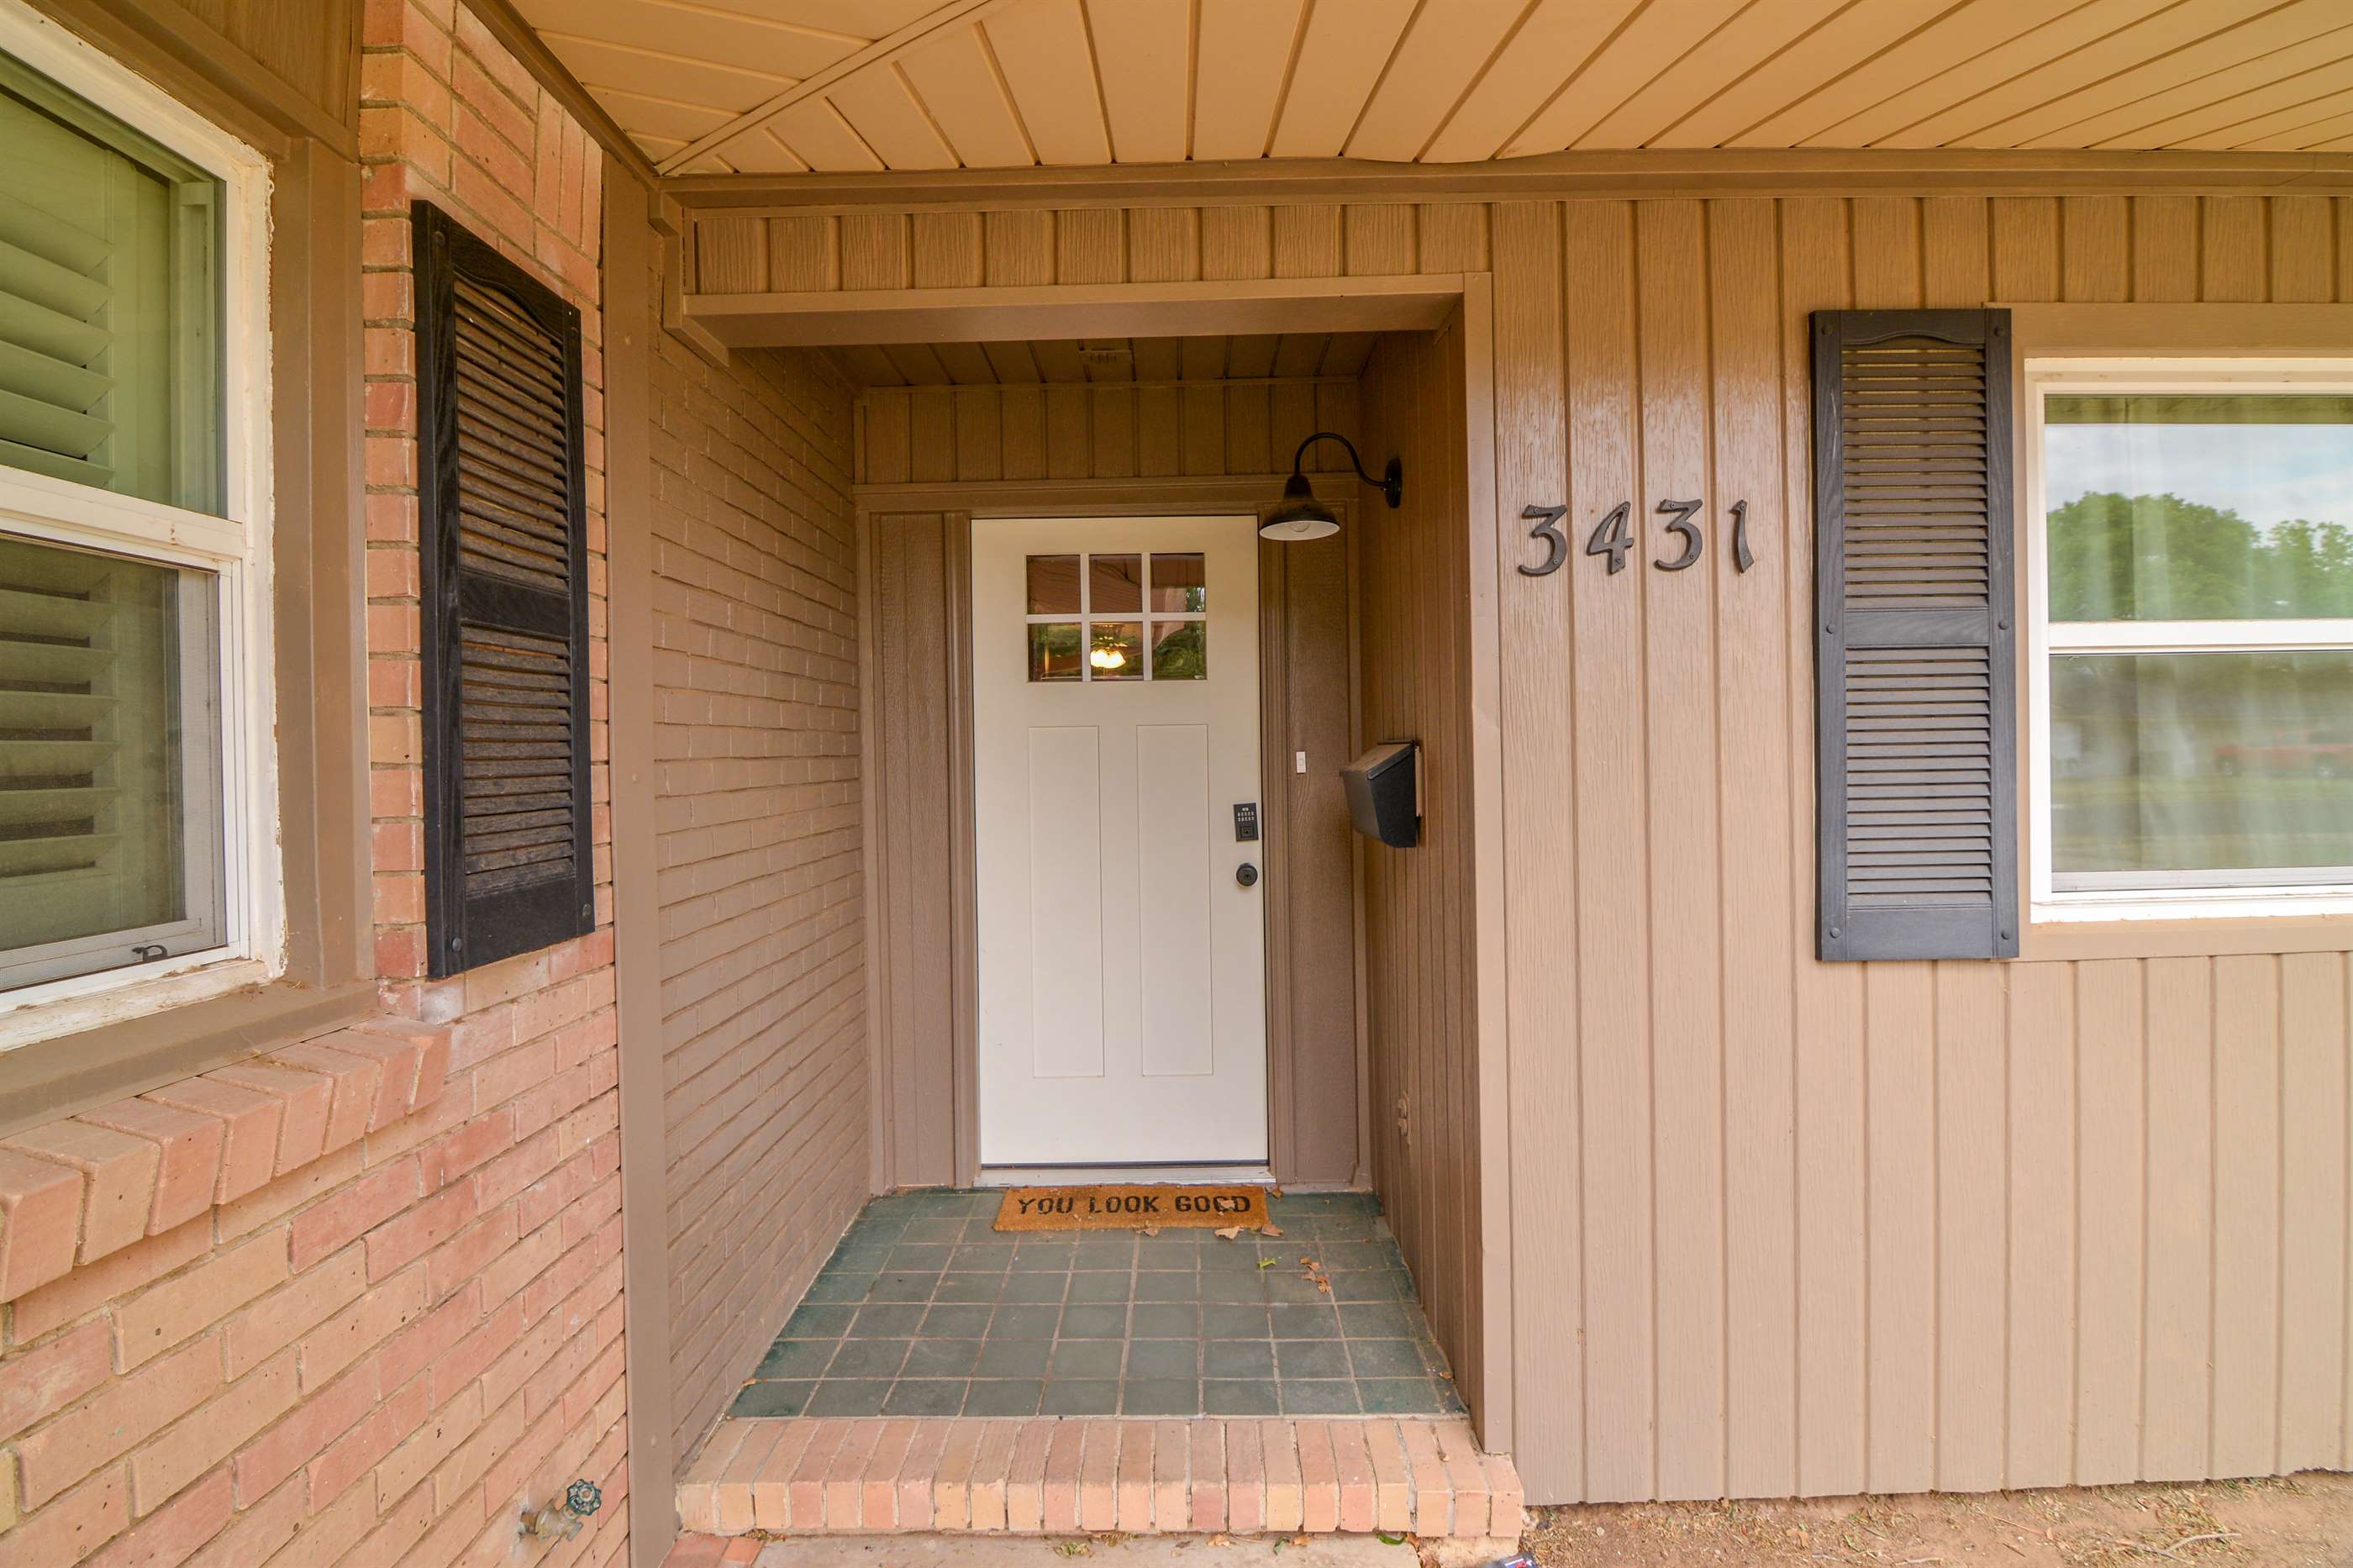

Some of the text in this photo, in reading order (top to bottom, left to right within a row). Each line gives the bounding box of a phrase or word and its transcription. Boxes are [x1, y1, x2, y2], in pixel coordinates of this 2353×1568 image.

[1517, 498, 1755, 575] 3431
[1018, 1196, 1074, 1214] YOU
[1089, 1196, 1160, 1213] LOOK
